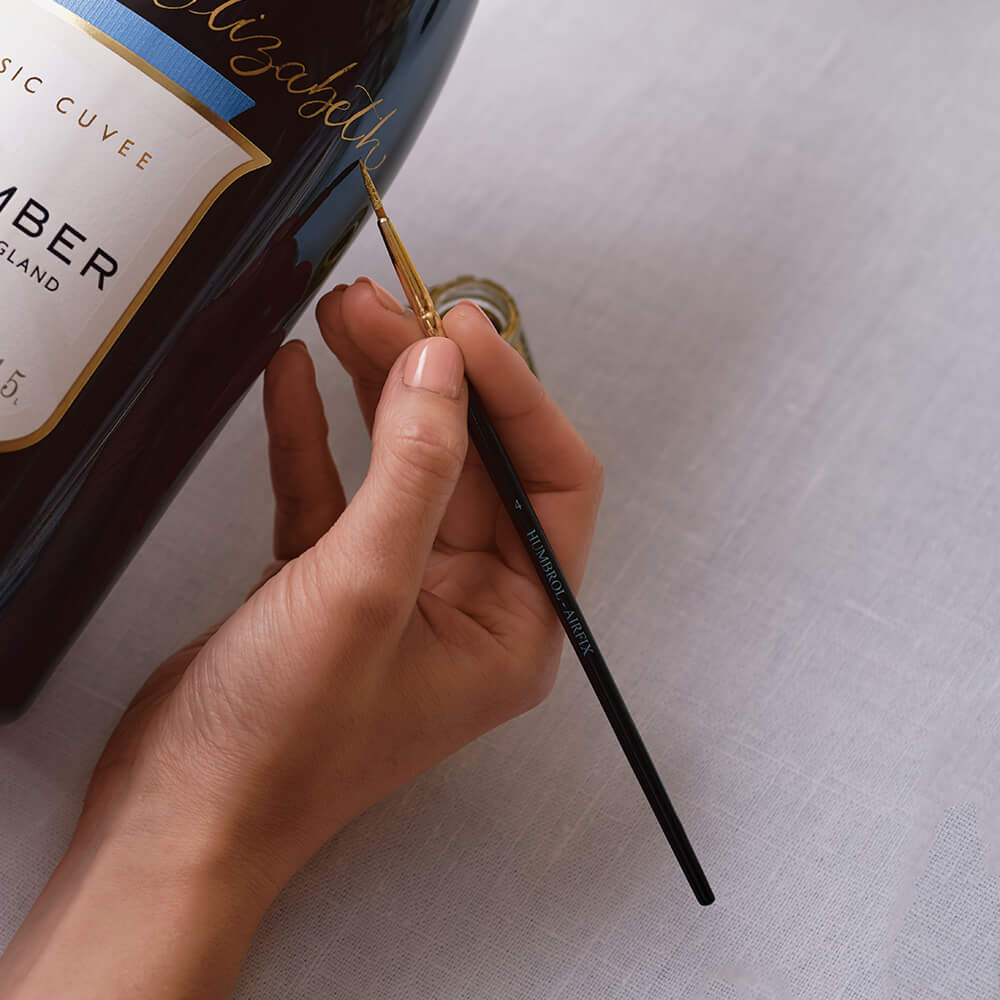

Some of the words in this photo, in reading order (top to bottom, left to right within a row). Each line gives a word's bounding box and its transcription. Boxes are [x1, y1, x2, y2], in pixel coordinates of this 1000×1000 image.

[55, 96, 154, 171] CUVEE
[526, 528, 567, 601] HUMBROL
[563, 608, 594, 656] AIRFIX
